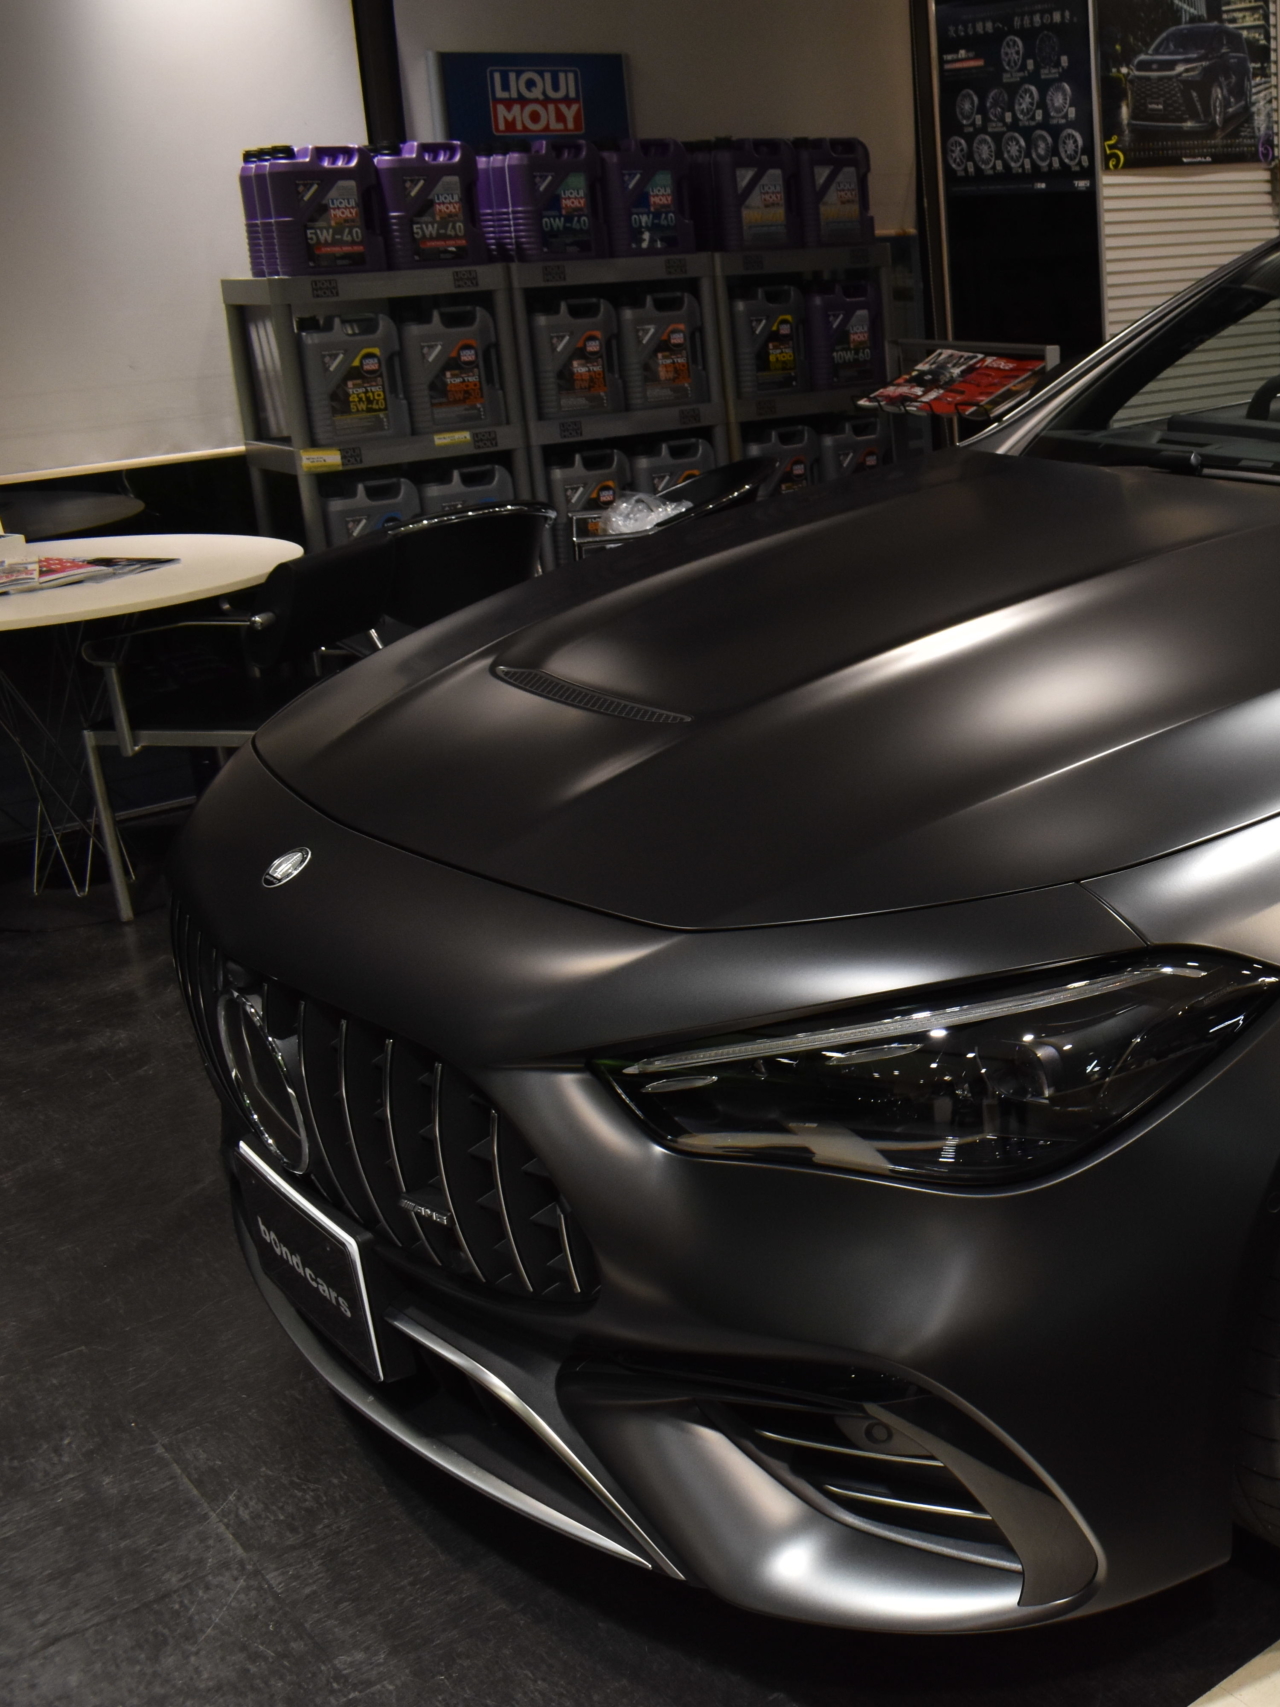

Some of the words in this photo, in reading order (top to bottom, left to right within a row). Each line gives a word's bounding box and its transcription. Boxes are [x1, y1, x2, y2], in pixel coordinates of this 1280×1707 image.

[492, 71, 577, 100] LIQUI
[496, 103, 580, 131] MOLY
[1258, 131, 1273, 164] 6
[1104, 135, 1126, 171] 5
[561, 189, 584, 198] LIQUI
[649, 187, 671, 195] LIQUI
[328, 198, 355, 207] LIQUI
[435, 193, 460, 203] LIQUI
[650, 195, 673, 204] MOLY
[435, 203, 461, 213] MOLY
[561, 199, 586, 208] MOLY
[330, 208, 357, 218] MOLY
[542, 216, 589, 232] 0W-40
[631, 213, 676, 228] 0W-40
[412, 222, 465, 239] 5W-40
[306, 228, 362, 244] 5W-40
[312, 279, 338, 288] LIQUI
[313, 288, 339, 297] MOLY
[833, 349, 871, 364] 10W-60
[349, 391, 384, 402] 4110
[350, 400, 386, 413] 5W-40
[473, 431, 497, 440] LIQUI
[474, 439, 498, 448] MOLY
